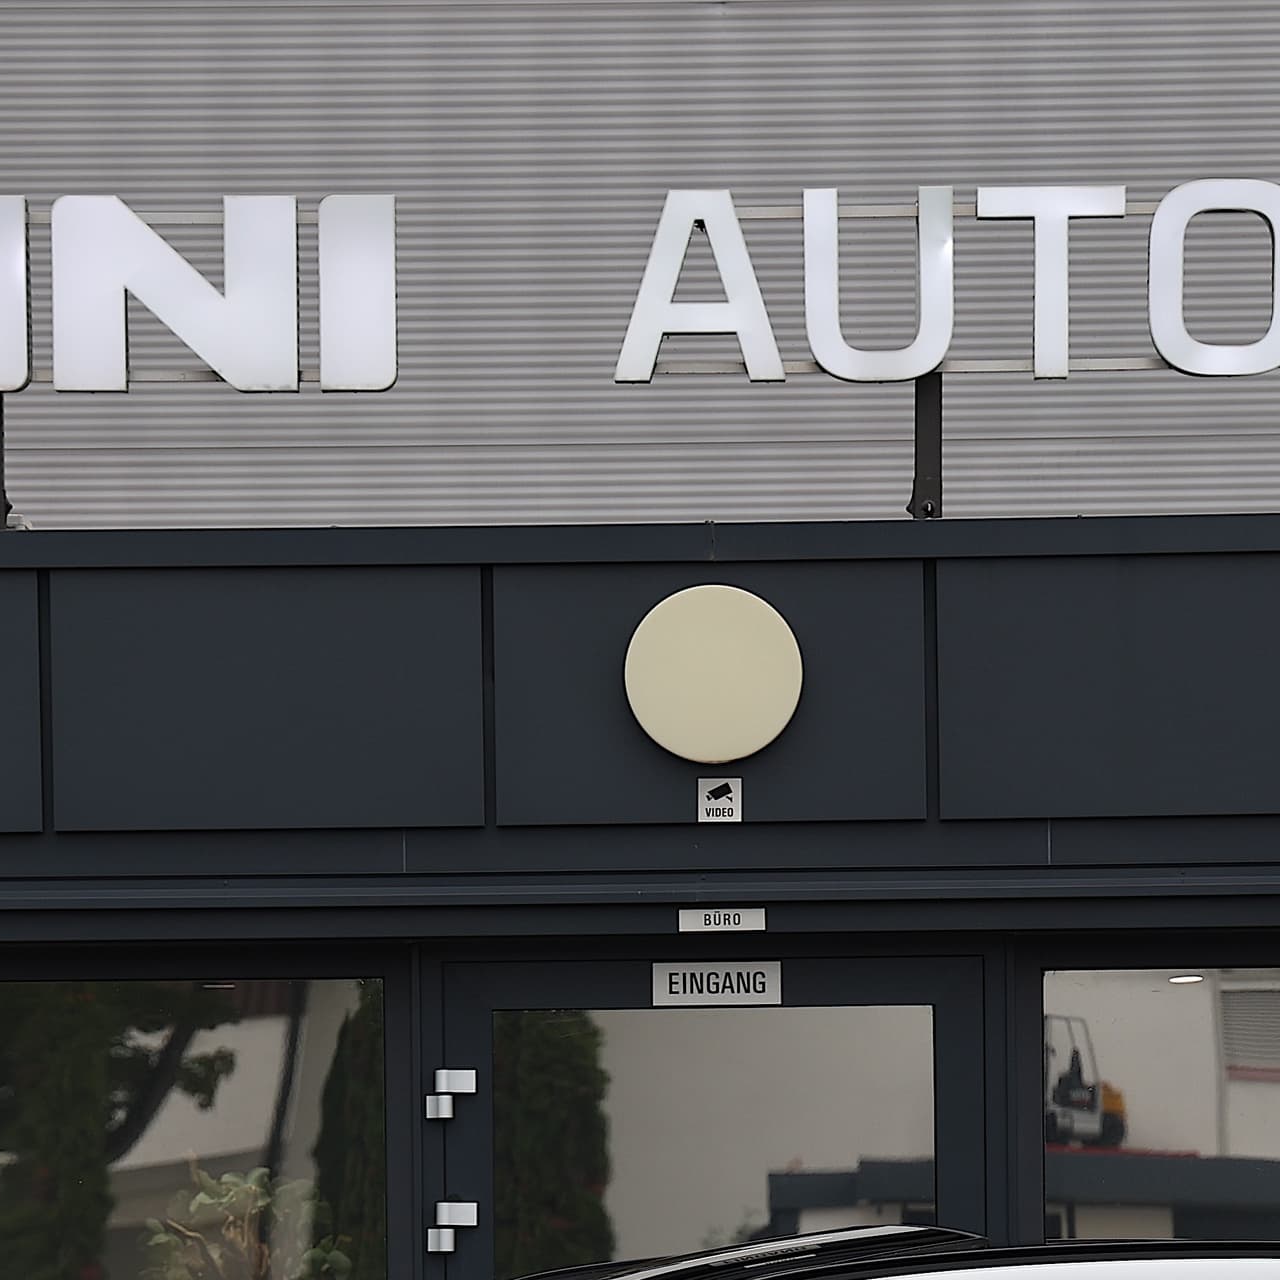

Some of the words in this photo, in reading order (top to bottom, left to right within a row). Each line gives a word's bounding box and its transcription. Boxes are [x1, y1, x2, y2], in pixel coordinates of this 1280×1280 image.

[705, 807, 734, 818] VIDEO
[703, 911, 742, 926] BÜRO
[668, 971, 767, 995] EINGANG
